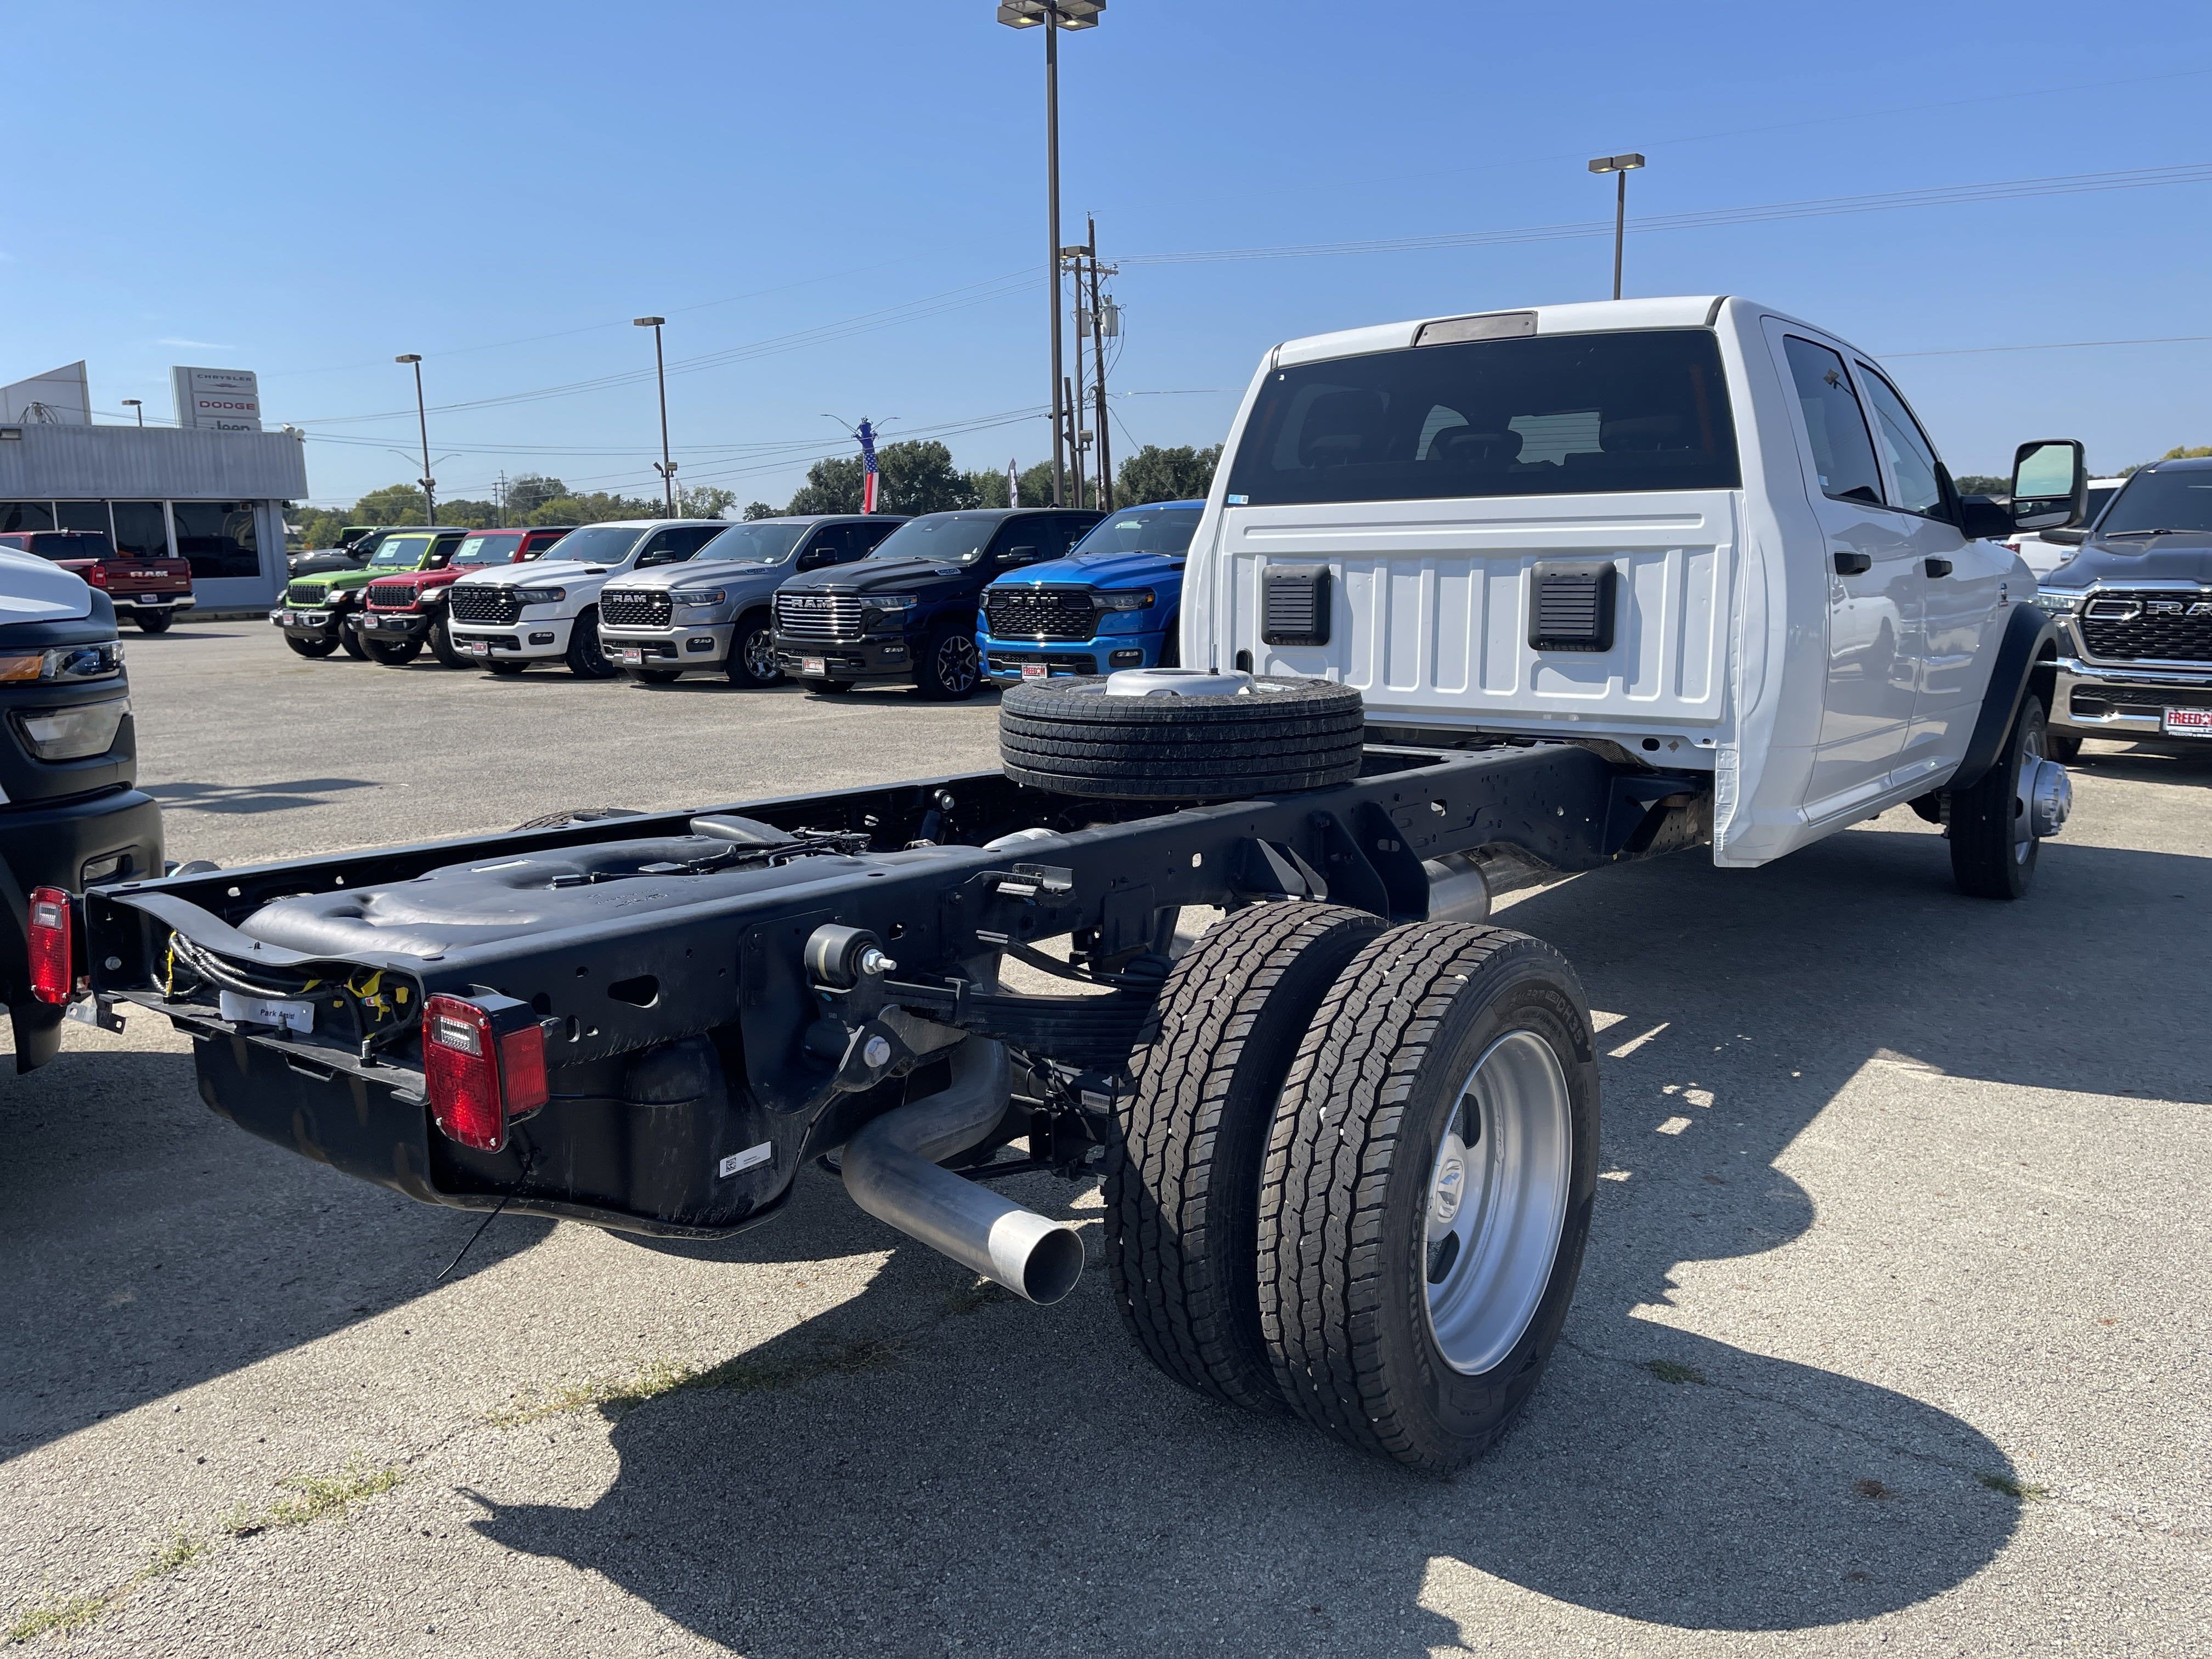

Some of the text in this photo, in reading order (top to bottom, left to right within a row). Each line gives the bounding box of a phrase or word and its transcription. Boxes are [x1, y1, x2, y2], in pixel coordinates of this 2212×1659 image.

[199, 401, 255, 410] DODGE
[612, 595, 647, 603] RAM
[791, 599, 832, 608] RAM
[1008, 596, 1058, 606] RAM
[2146, 601, 2212, 616] RA
